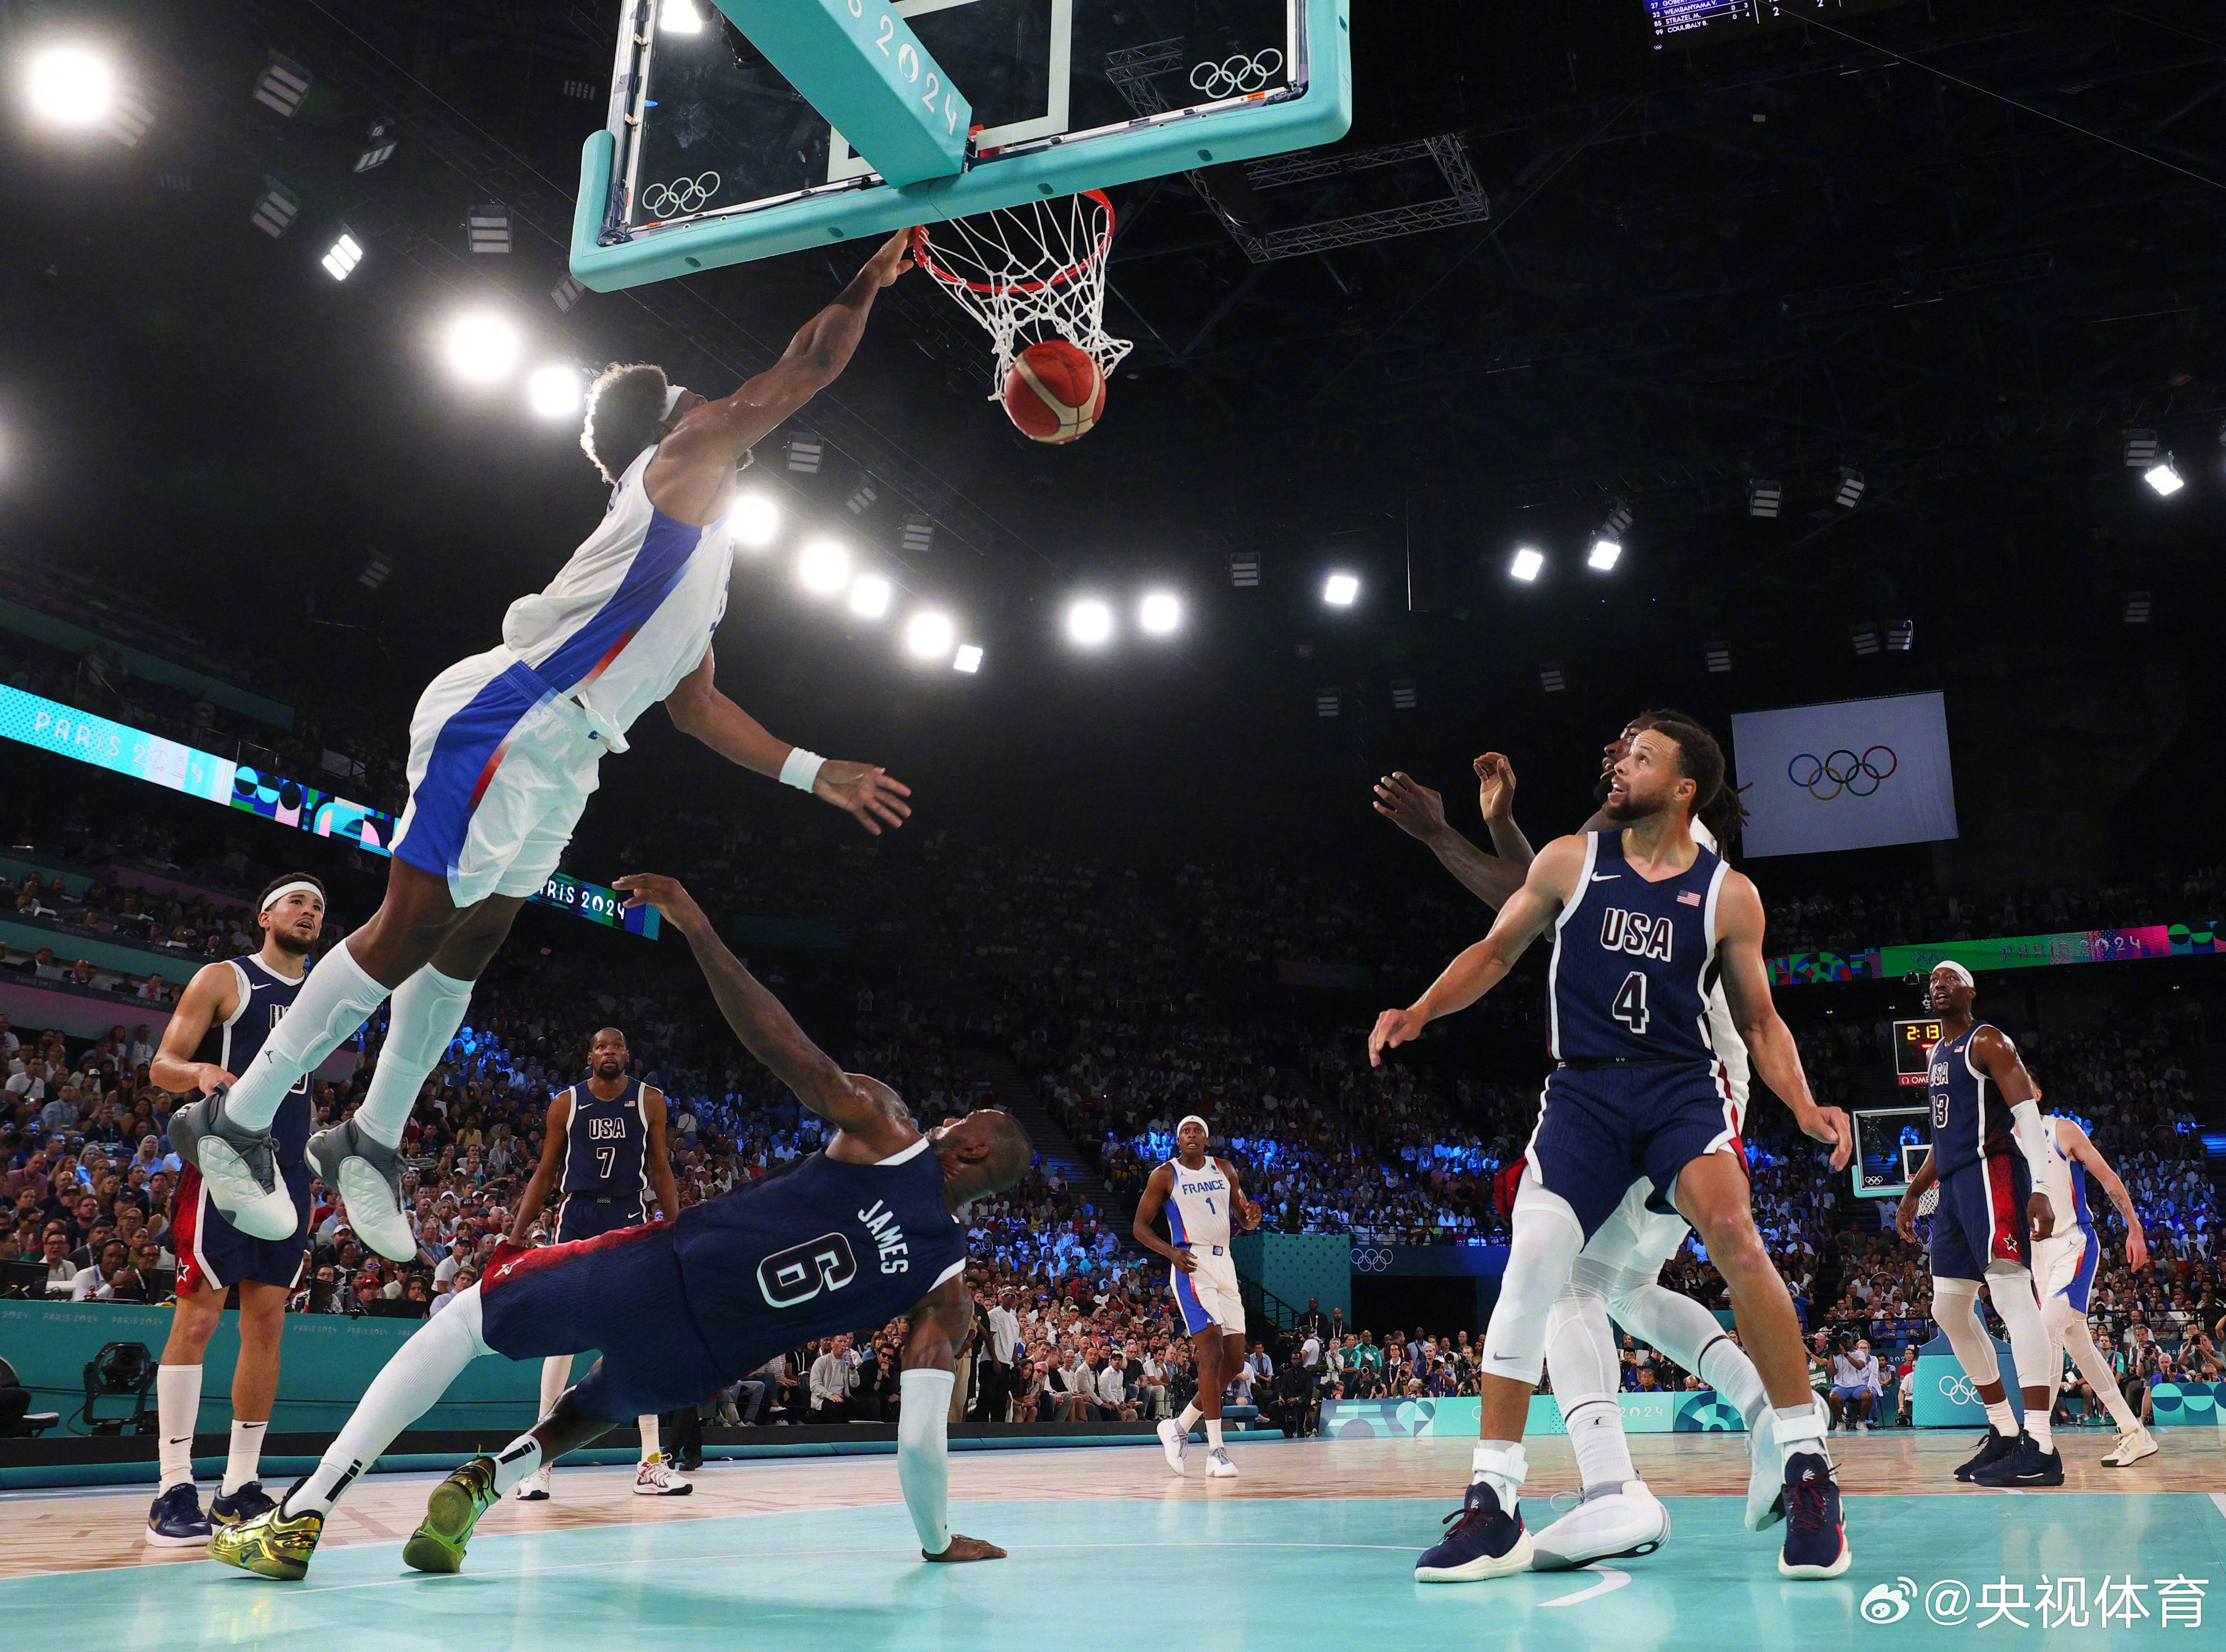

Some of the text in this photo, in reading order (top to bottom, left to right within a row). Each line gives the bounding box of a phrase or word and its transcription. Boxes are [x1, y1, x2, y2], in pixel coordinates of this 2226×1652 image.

[1664, 1, 1711, 15] WEMBANYAMA
[1773, 7, 1780, 16] 2
[1665, 14, 1692, 24] STRAZEL
[1668, 21, 1701, 33] COULIBALY
[875, 15, 957, 135] 2024
[540, 880, 624, 920] RIS 2024
[1600, 907, 1673, 962] USA
[1612, 971, 1649, 1034] 4
[1907, 1025, 1939, 1040] 2:13
[1911, 1076, 1929, 1084] OME
[589, 1118, 625, 1139] USA
[596, 1147, 615, 1178] 7
[1182, 1180, 1225, 1195] FRANCE
[1206, 1198, 1215, 1215] 1
[858, 1199, 909, 1274] JAMES
[756, 1232, 857, 1308] 6
[1620, 1406, 1663, 1417] 2024
